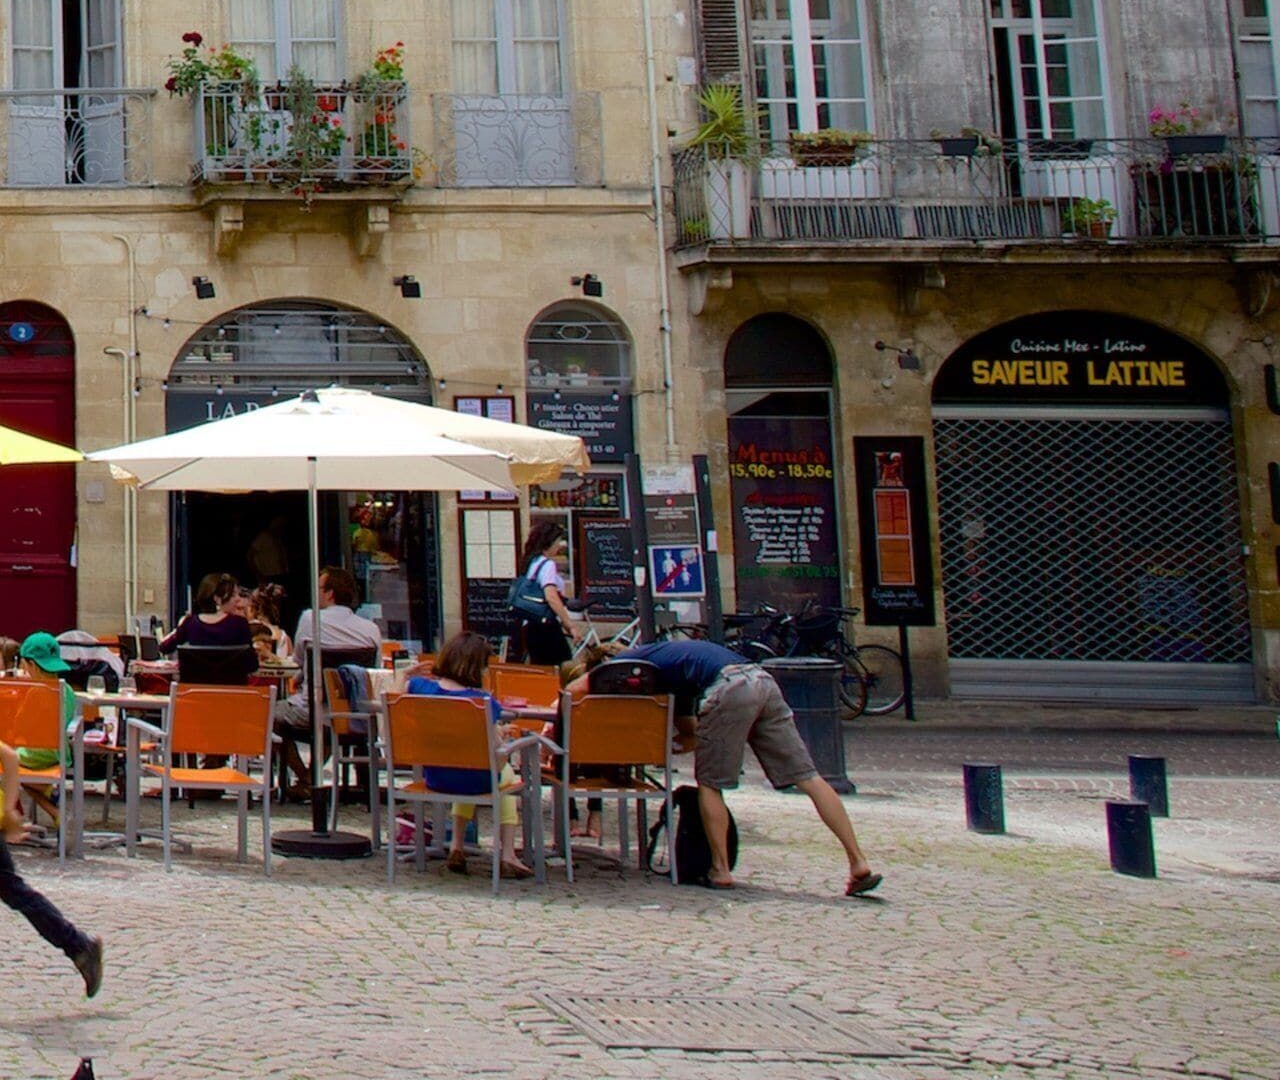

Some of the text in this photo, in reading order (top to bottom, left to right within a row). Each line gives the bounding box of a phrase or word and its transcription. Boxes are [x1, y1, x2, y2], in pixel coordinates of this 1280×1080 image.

[17, 327, 26, 338] 2
[1010, 339, 1060, 353] Cuisine
[1064, 339, 1090, 352] Mex
[1104, 339, 1146, 353] Latino
[972, 360, 1185, 386] SAVEUR LATINE
[206, 401, 236, 421] LA
[533, 403, 566, 411] Ptissier
[573, 403, 619, 411] Chocoatier
[552, 411, 602, 420] Salon de Thé
[538, 419, 571, 429] Gâteaux
[579, 422, 616, 431] emporter
[736, 444, 808, 463] Menus
